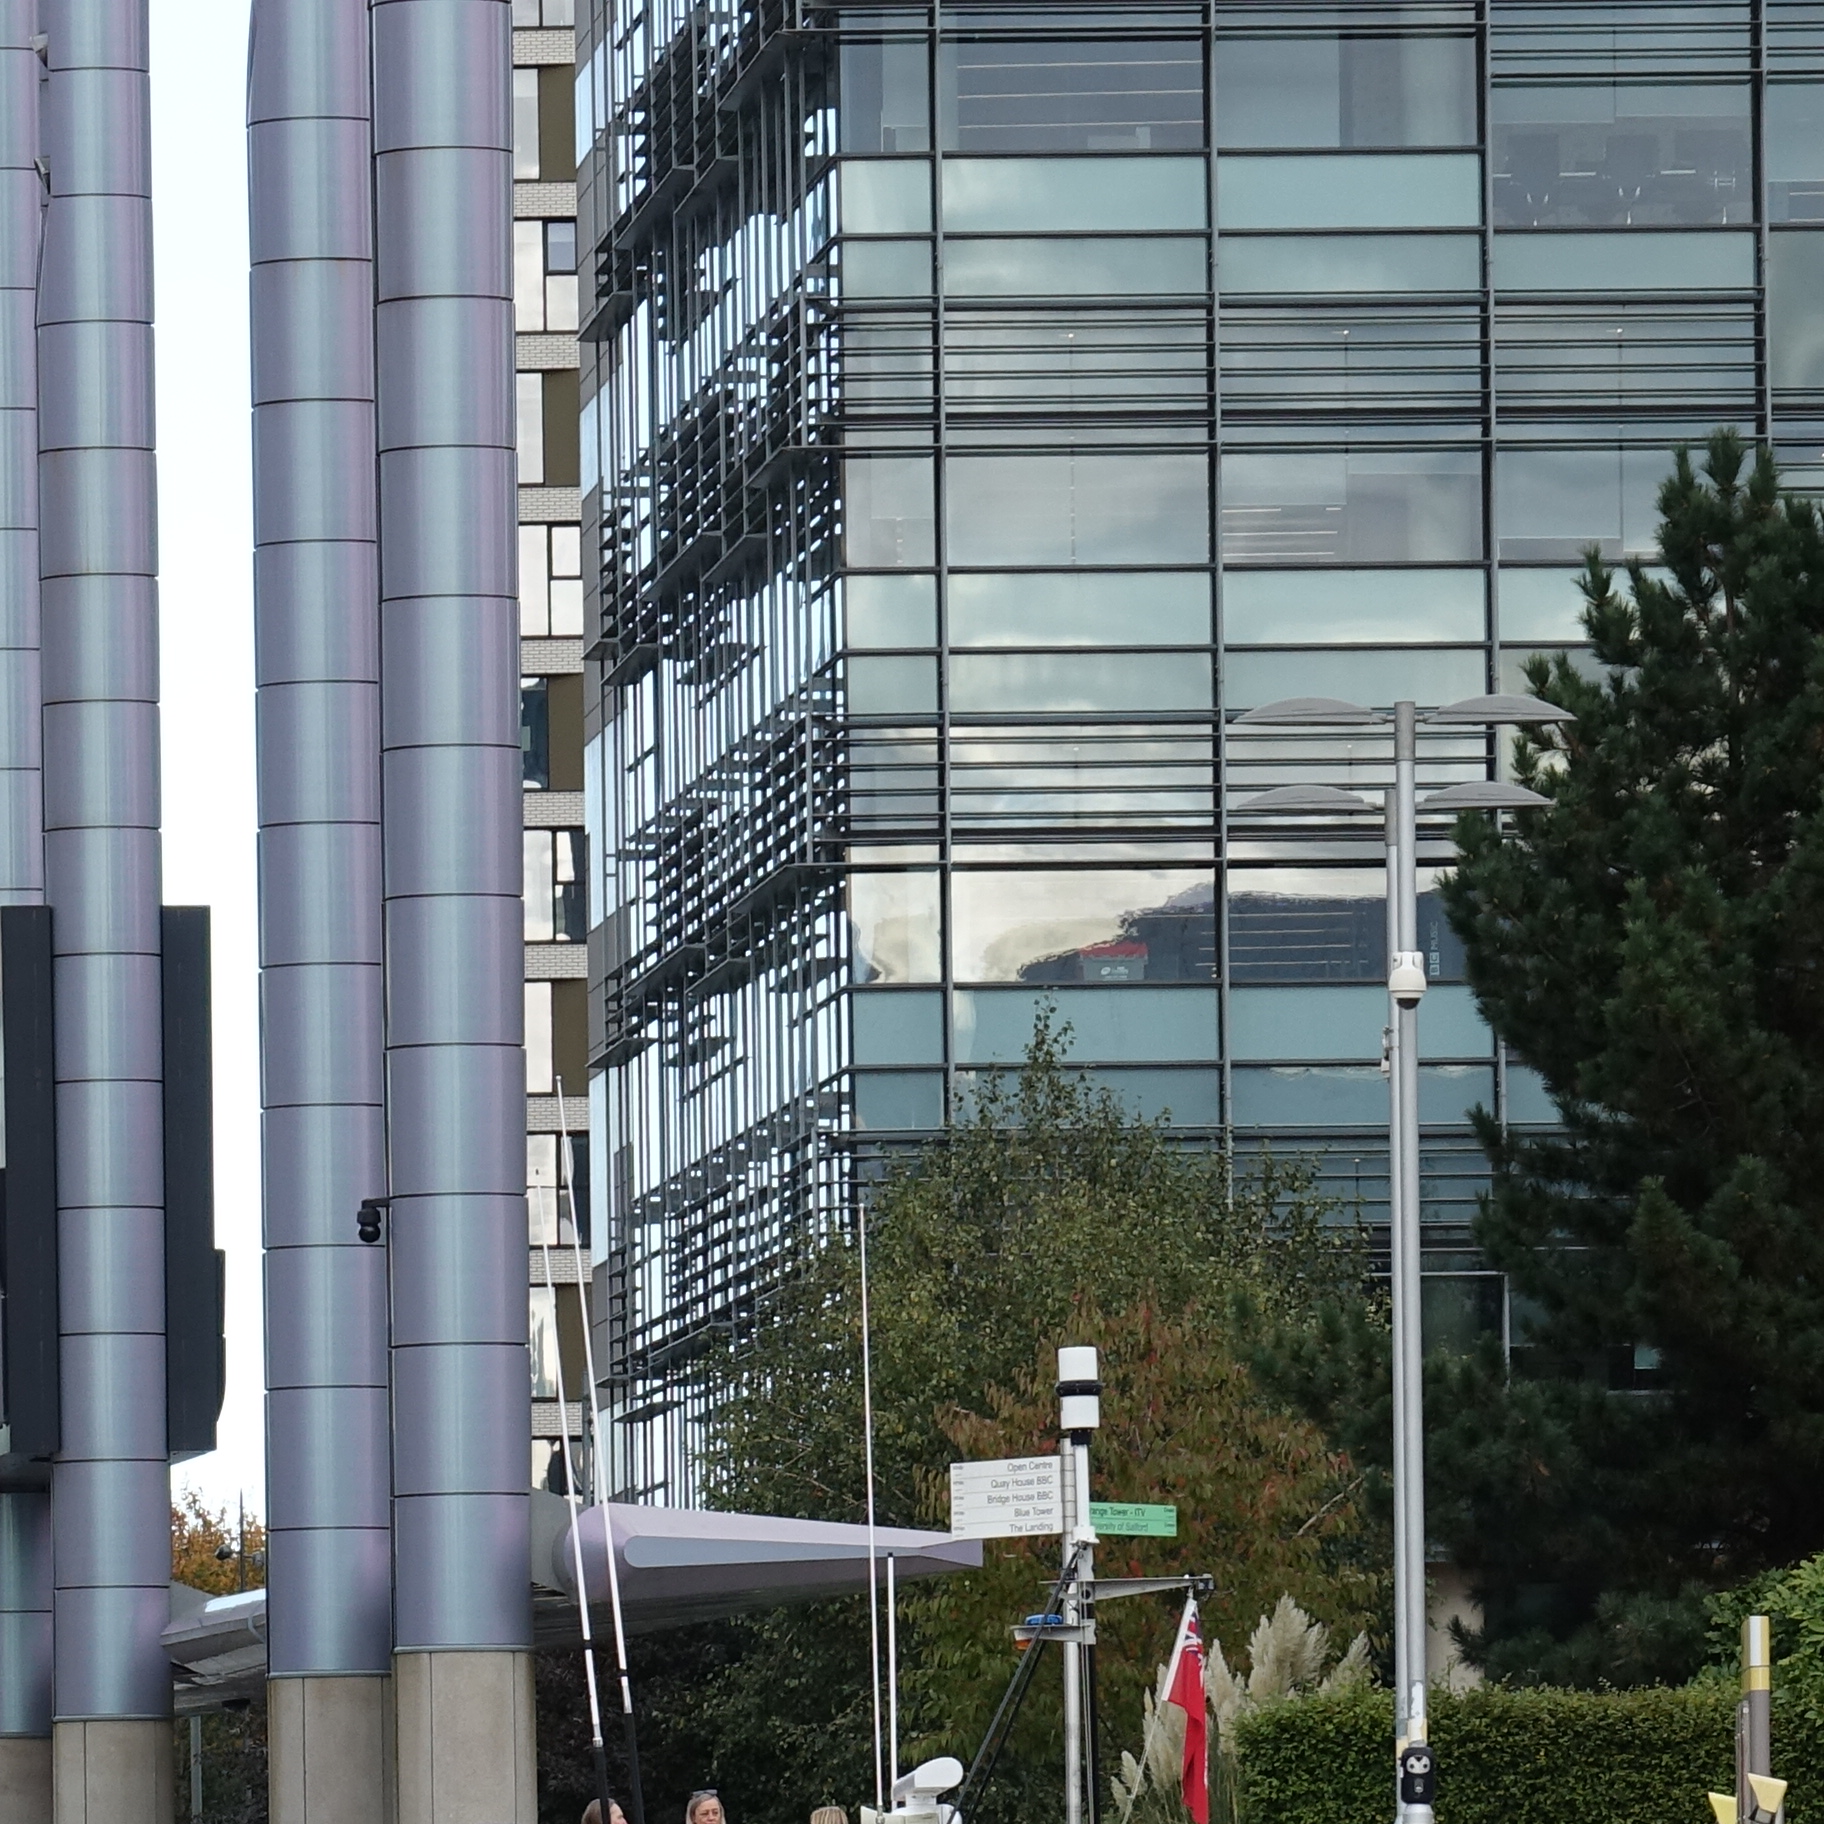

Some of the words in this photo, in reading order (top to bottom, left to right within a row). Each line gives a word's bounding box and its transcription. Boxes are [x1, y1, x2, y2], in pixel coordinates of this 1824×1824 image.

[1007, 1462, 1027, 1473] Open
[1028, 1460, 1053, 1470] Centre
[990, 1479, 1010, 1489] Quay
[1012, 1478, 1034, 1487] House
[1037, 1475, 1053, 1485] BBC
[987, 1494, 1010, 1505] Bridge
[1012, 1493, 1035, 1502] House
[1037, 1491, 1053, 1500] BBC
[1014, 1507, 1030, 1517] Blue
[1032, 1506, 1054, 1515] Tower
[1109, 1506, 1129, 1516] Tower
[1134, 1507, 1146, 1516] ITV
[1009, 1523, 1022, 1532] The
[1025, 1522, 1053, 1532] Landing
